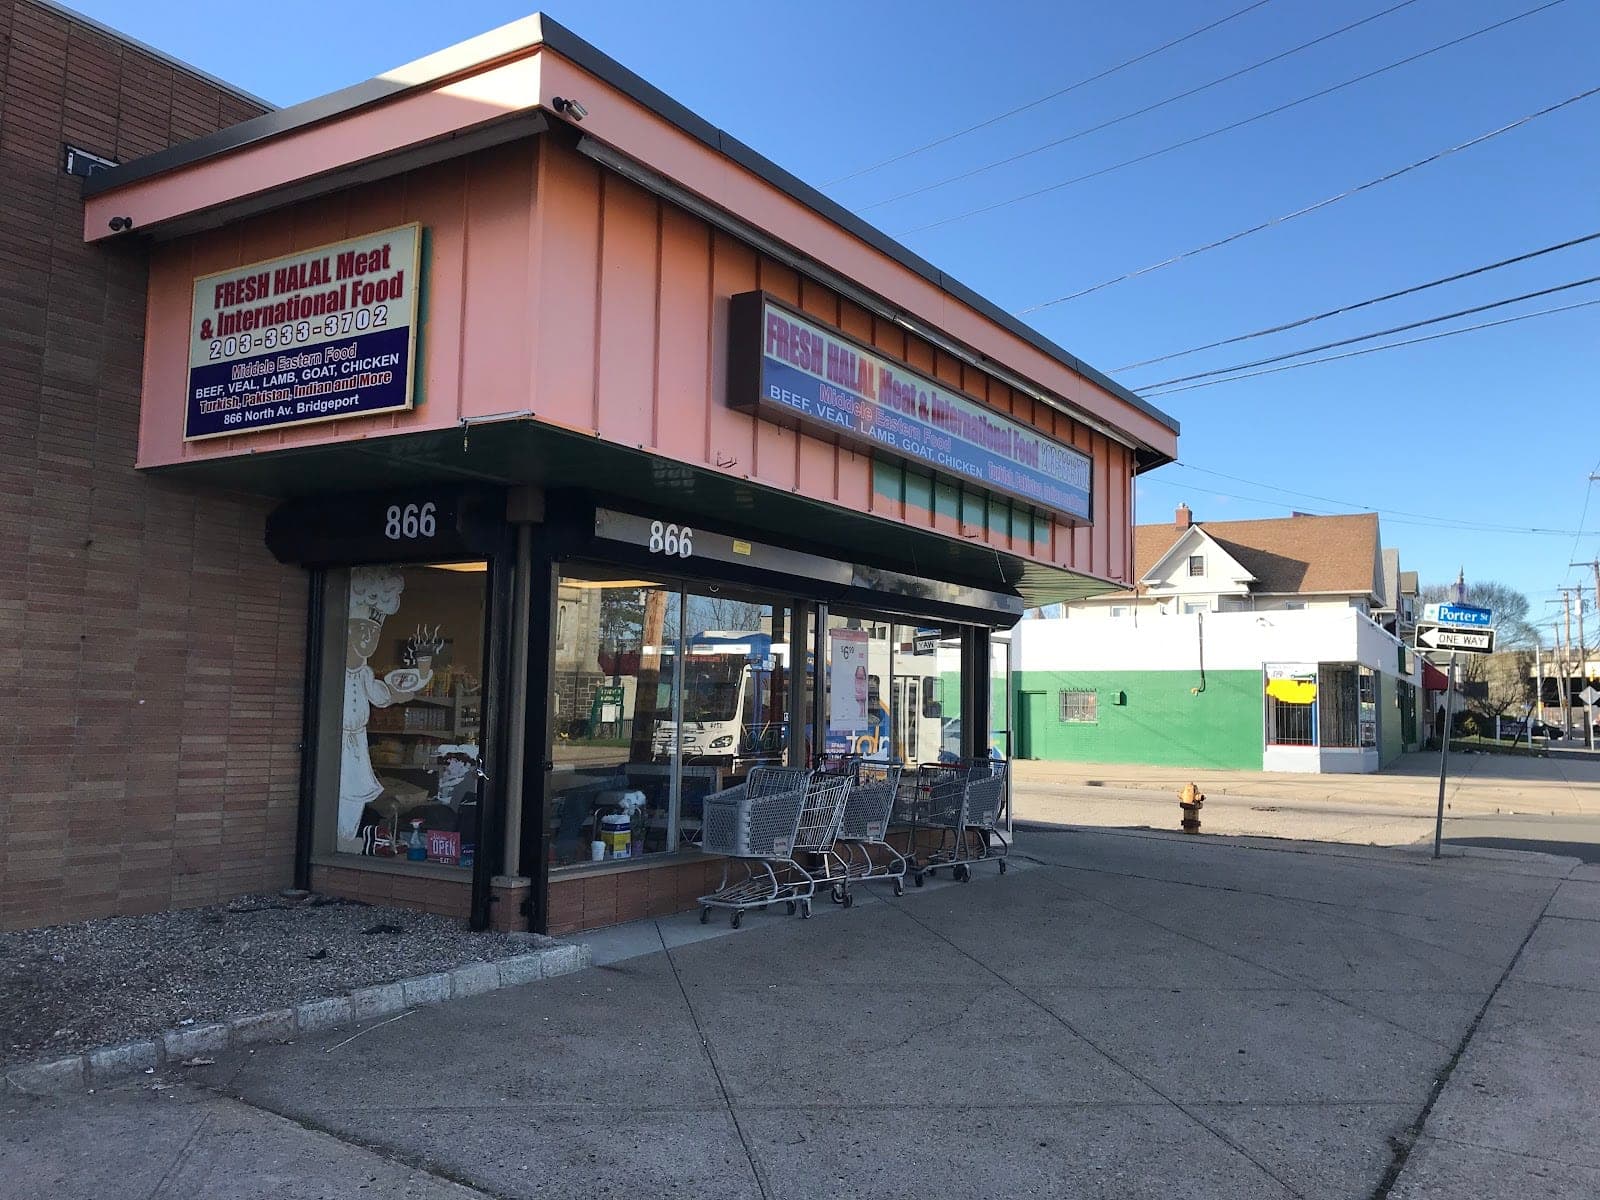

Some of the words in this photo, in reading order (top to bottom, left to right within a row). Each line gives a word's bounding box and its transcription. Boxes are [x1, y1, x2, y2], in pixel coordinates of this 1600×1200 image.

[214, 271, 270, 309] FRESH
[273, 257, 332, 295] HALAL
[336, 244, 391, 281] Meat
[200, 318, 214, 341] &
[217, 286, 347, 337] International
[351, 271, 405, 307] Food
[209, 305, 388, 360] 203-333-3702
[195, 384, 225, 400] BEEF,
[228, 378, 260, 394] VEAL,
[263, 371, 298, 388] LAMB,
[302, 364, 338, 383] GOAT,
[341, 353, 400, 374] CHICKEN
[231, 358, 275, 381] Middele
[277, 351, 322, 371] Eastern
[324, 342, 358, 364] Food
[766, 312, 824, 376] FRESH
[827, 341, 876, 400] HALAL
[878, 366, 917, 417] Meat
[199, 395, 241, 414] Turkish,
[242, 388, 292, 408] Pakistan,
[293, 380, 332, 399] Indian
[333, 375, 358, 392] and
[358, 371, 393, 388] More
[224, 411, 242, 425] 866
[244, 405, 275, 422] North
[276, 402, 294, 417] Av.
[296, 394, 360, 414] Bridgeport
[770, 384, 812, 416] BEEF,
[816, 403, 857, 432] VEAL,
[860, 421, 899, 449] LAMB,
[902, 438, 935, 461] GOAT,
[938, 452, 983, 478] CHICKEN
[385, 502, 437, 540] 866
[649, 520, 693, 559] 866
[1440, 606, 1477, 622] Porter
[1439, 634, 1459, 645] ONE
[1463, 635, 1484, 646] WAY
[432, 840, 456, 857] OPEN
